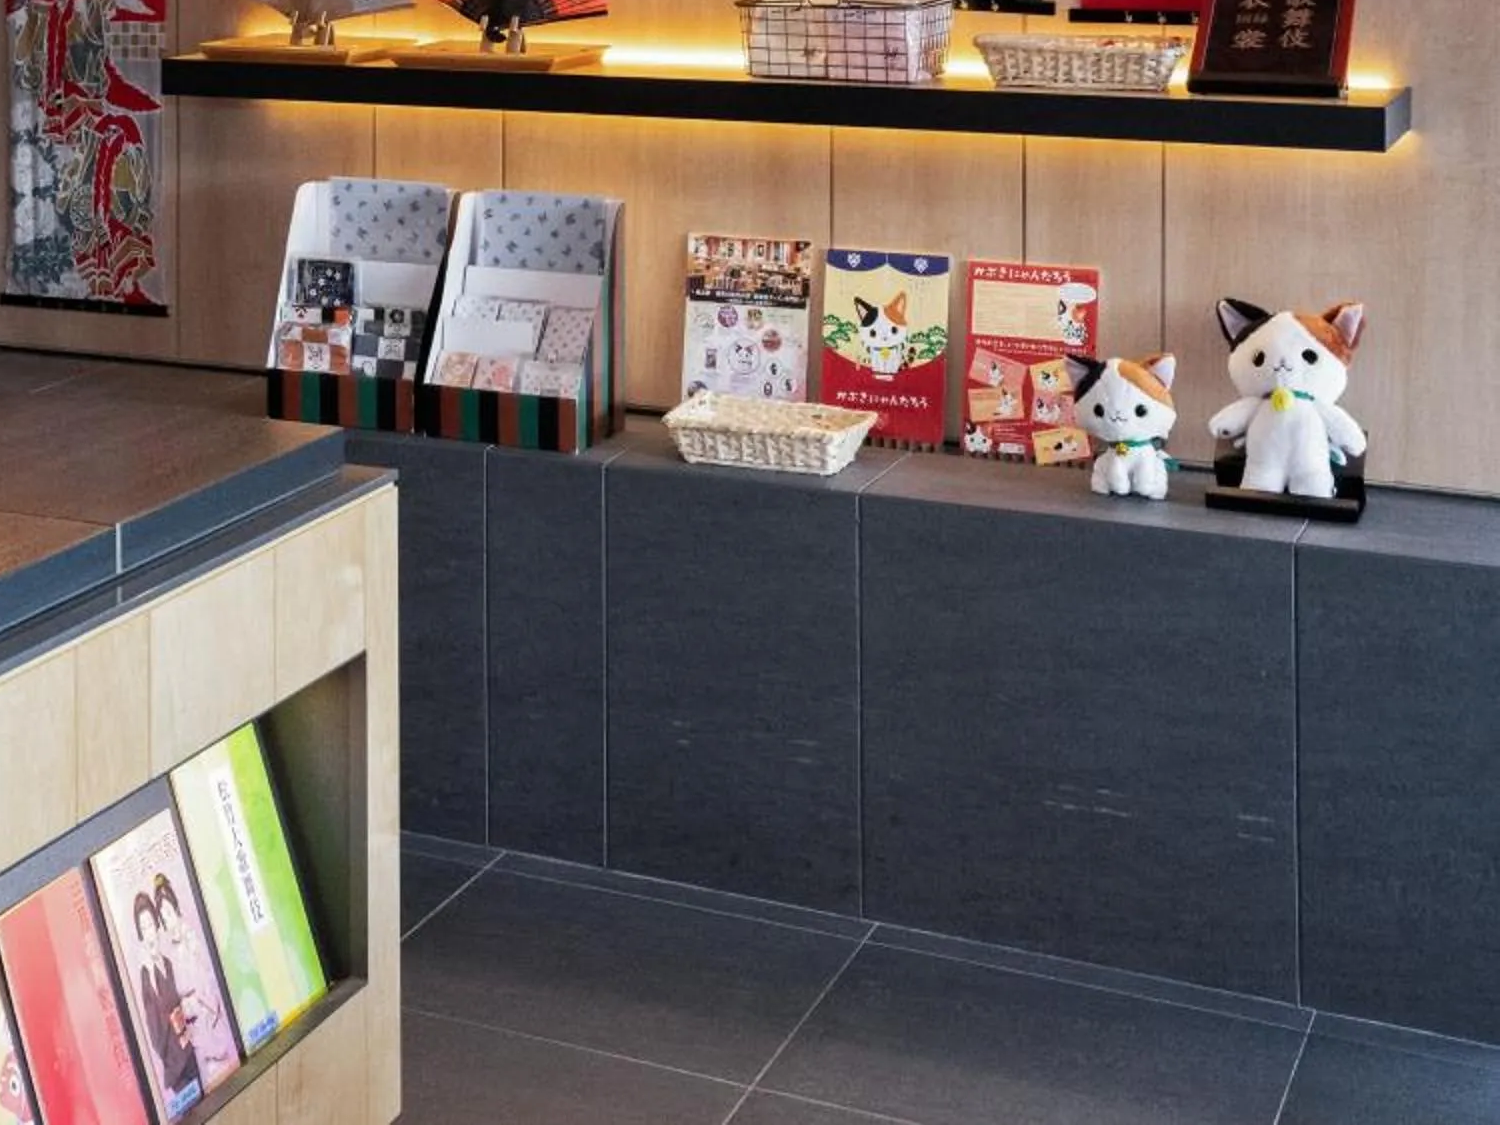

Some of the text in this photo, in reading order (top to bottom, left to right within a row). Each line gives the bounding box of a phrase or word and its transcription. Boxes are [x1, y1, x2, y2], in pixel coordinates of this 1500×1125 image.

[973, 266, 1072, 283] かぶきにゃんたろう
[836, 391, 930, 409] かぶきにゃんたろう
